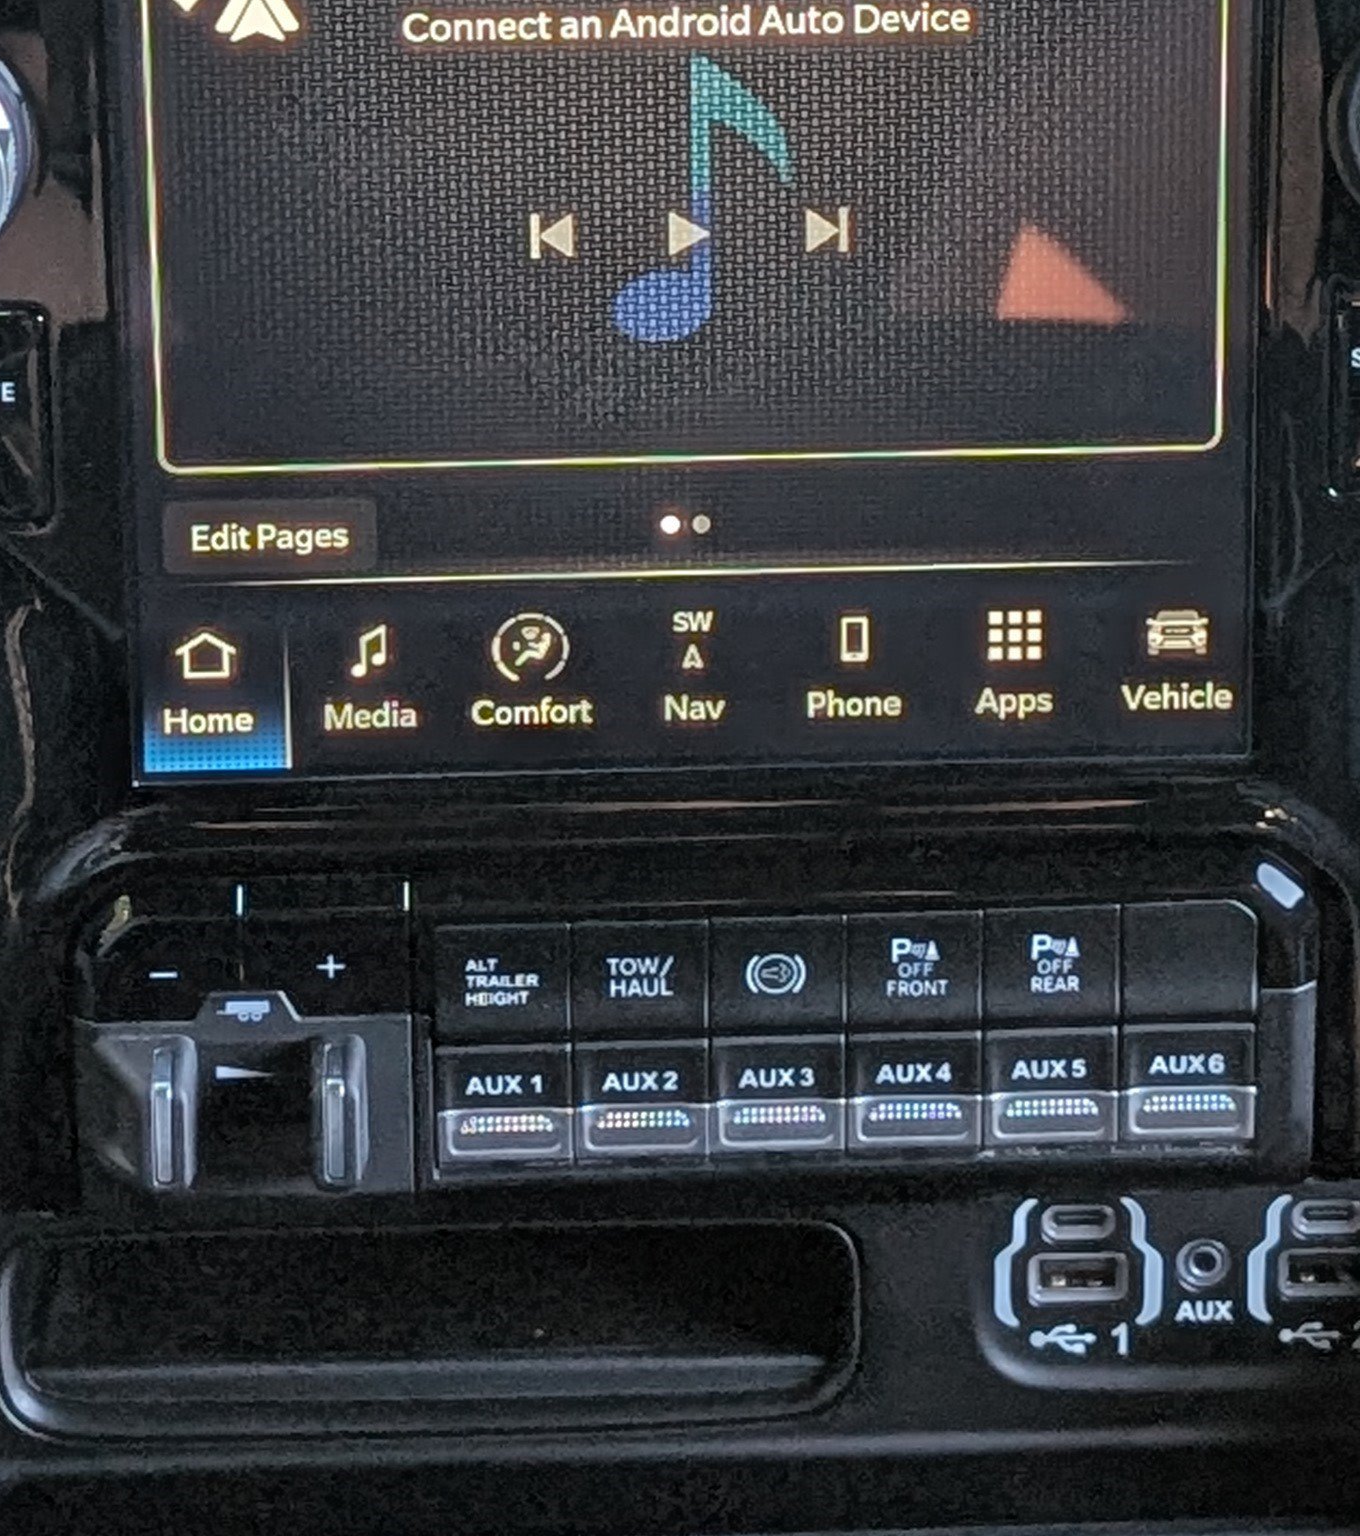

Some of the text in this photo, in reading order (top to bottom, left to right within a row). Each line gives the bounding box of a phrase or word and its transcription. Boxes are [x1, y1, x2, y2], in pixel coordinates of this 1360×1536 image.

[402, 2, 971, 43] Connect an Android Auto Device
[191, 522, 349, 556] Edit Pages
[673, 611, 713, 633] SW
[807, 690, 902, 719] Phone
[975, 687, 1052, 720] Apps
[1122, 681, 1233, 711] Vehicle
[324, 701, 418, 730] Media
[471, 697, 593, 726] Comfort
[664, 694, 726, 721] Nav
[163, 708, 254, 734] Home
[465, 959, 497, 973] ALT
[606, 956, 674, 976] TOW/
[898, 963, 934, 977] OFF
[1038, 959, 1073, 974] OFF
[465, 974, 539, 988] TRAILER
[610, 978, 674, 998] HAUL
[887, 979, 949, 997] FRONT
[1031, 976, 1079, 993] REAR
[465, 991, 530, 1007] HEIGHT
[876, 1063, 952, 1084] AUX 4
[1011, 1059, 1087, 1080] AUX 5
[1149, 1054, 1225, 1075] AUX 6
[465, 1074, 543, 1096] AUX 1
[601, 1071, 679, 1092] AUX 2
[739, 1068, 815, 1088] AUX 3
[1175, 1300, 1233, 1322] AUX
[1111, 1322, 1129, 1356] 1
